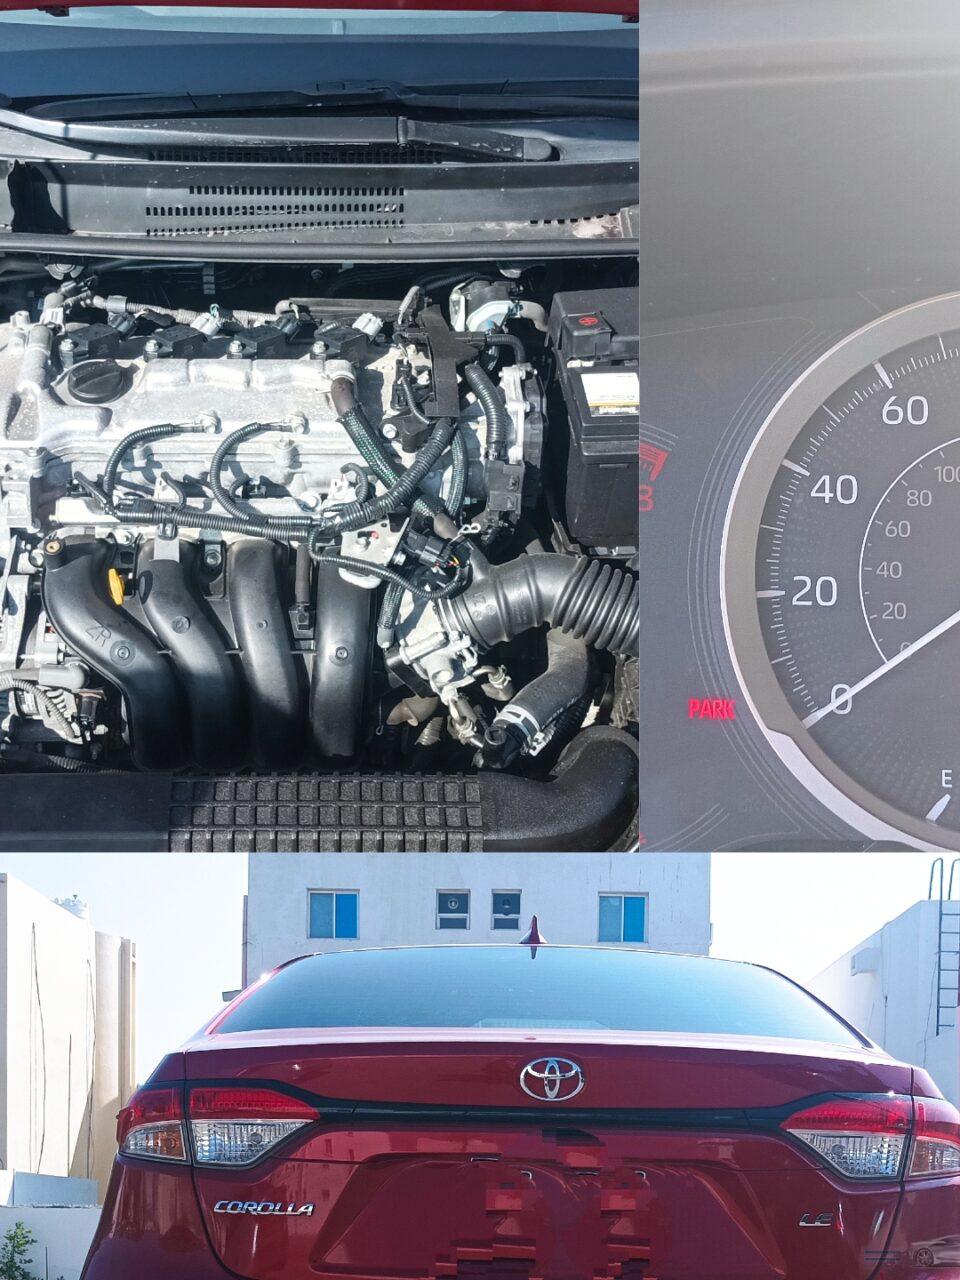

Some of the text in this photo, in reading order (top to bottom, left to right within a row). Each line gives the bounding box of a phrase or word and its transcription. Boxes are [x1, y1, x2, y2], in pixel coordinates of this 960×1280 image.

[882, 395, 929, 425] 60
[810, 475, 858, 505] 40
[906, 489, 932, 507] 80
[885, 520, 911, 538] 60
[875, 561, 902, 579] 40
[791, 576, 838, 606] 20
[882, 602, 907, 620] 20
[831, 684, 852, 714] 0
[688, 698, 735, 720] PARK
[941, 769, 953, 788] E
[213, 1200, 315, 1216] COROLLA
[799, 1213, 833, 1226] LE
